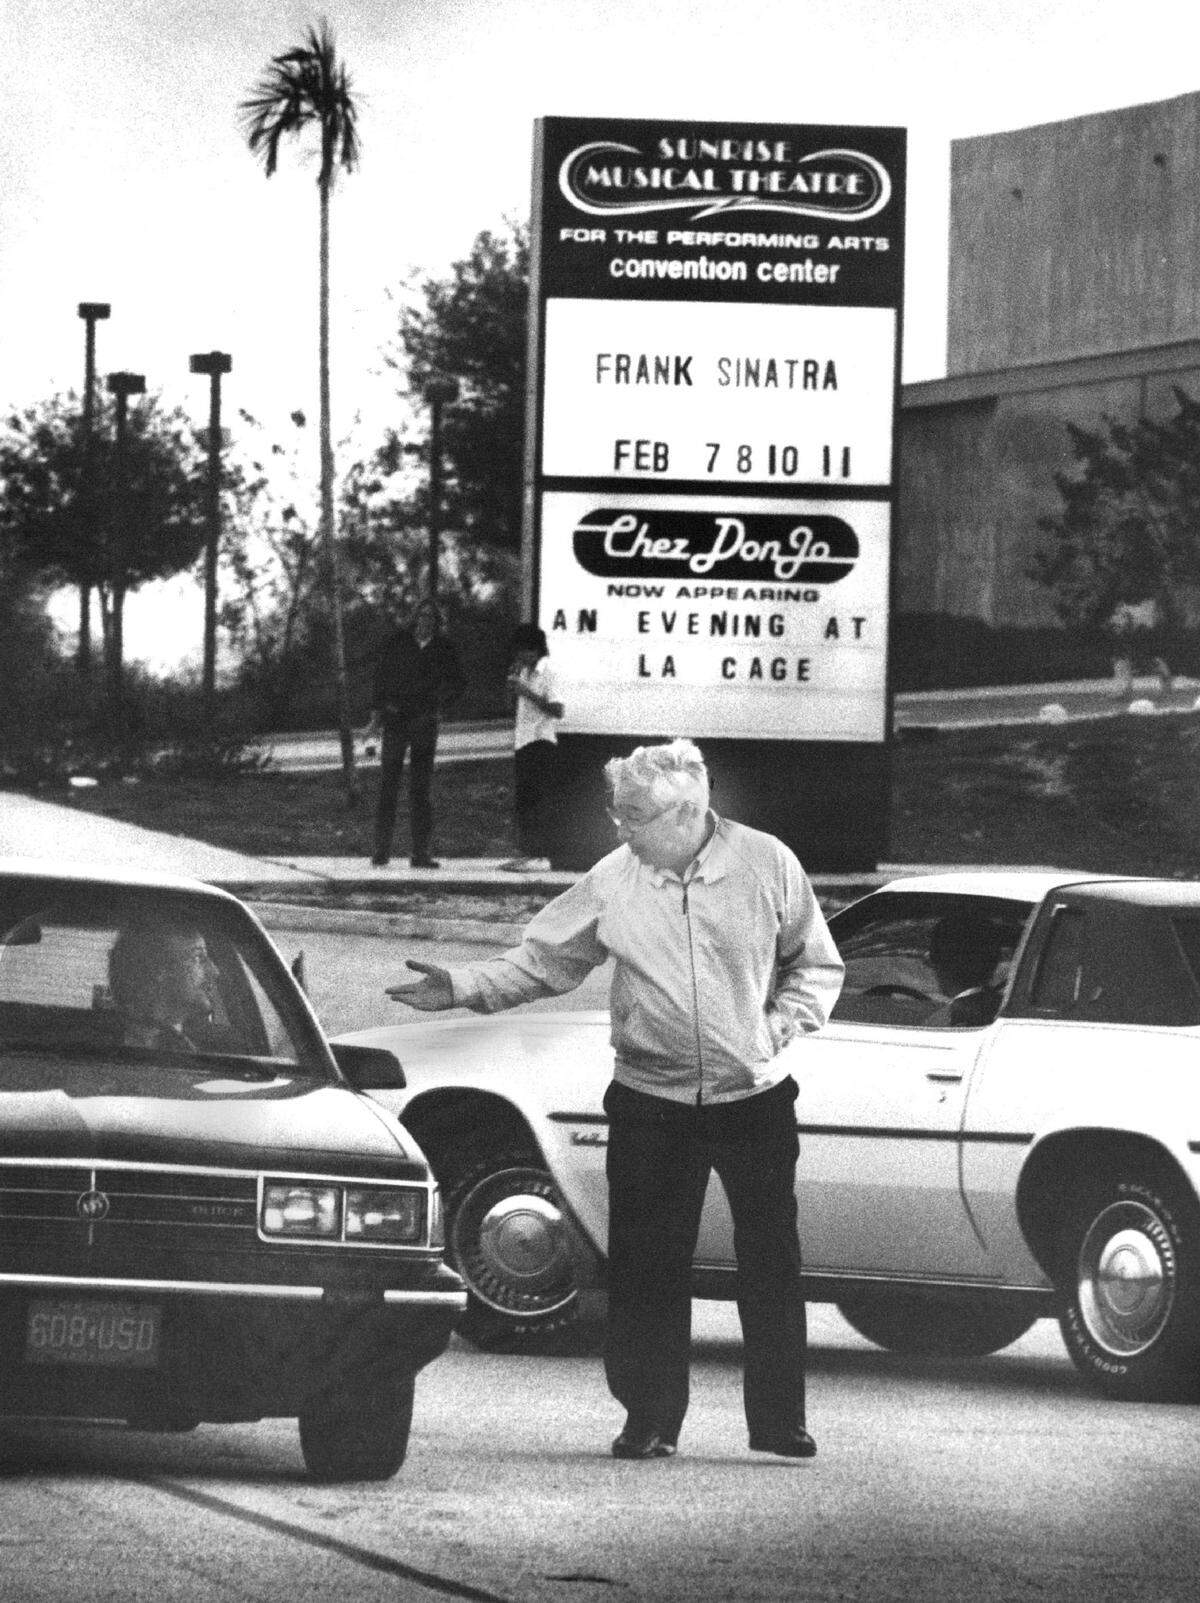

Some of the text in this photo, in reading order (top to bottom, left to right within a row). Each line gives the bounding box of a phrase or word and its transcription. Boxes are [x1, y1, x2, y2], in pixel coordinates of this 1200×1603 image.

[658, 136, 793, 162] SUNRISE
[585, 165, 866, 195] MUSICAL THEATRE
[560, 228, 890, 251] FOR THE PERFORMING ARTS
[610, 256, 840, 283] convention center
[596, 353, 837, 390] FRANK SINATRA
[614, 439, 850, 478] FEB 7 8 10 11
[604, 514, 692, 560] Chez
[607, 584, 820, 602] NOW APPEARING
[552, 609, 866, 639] AN EVENING AT
[638, 654, 812, 682] LA CAGE
